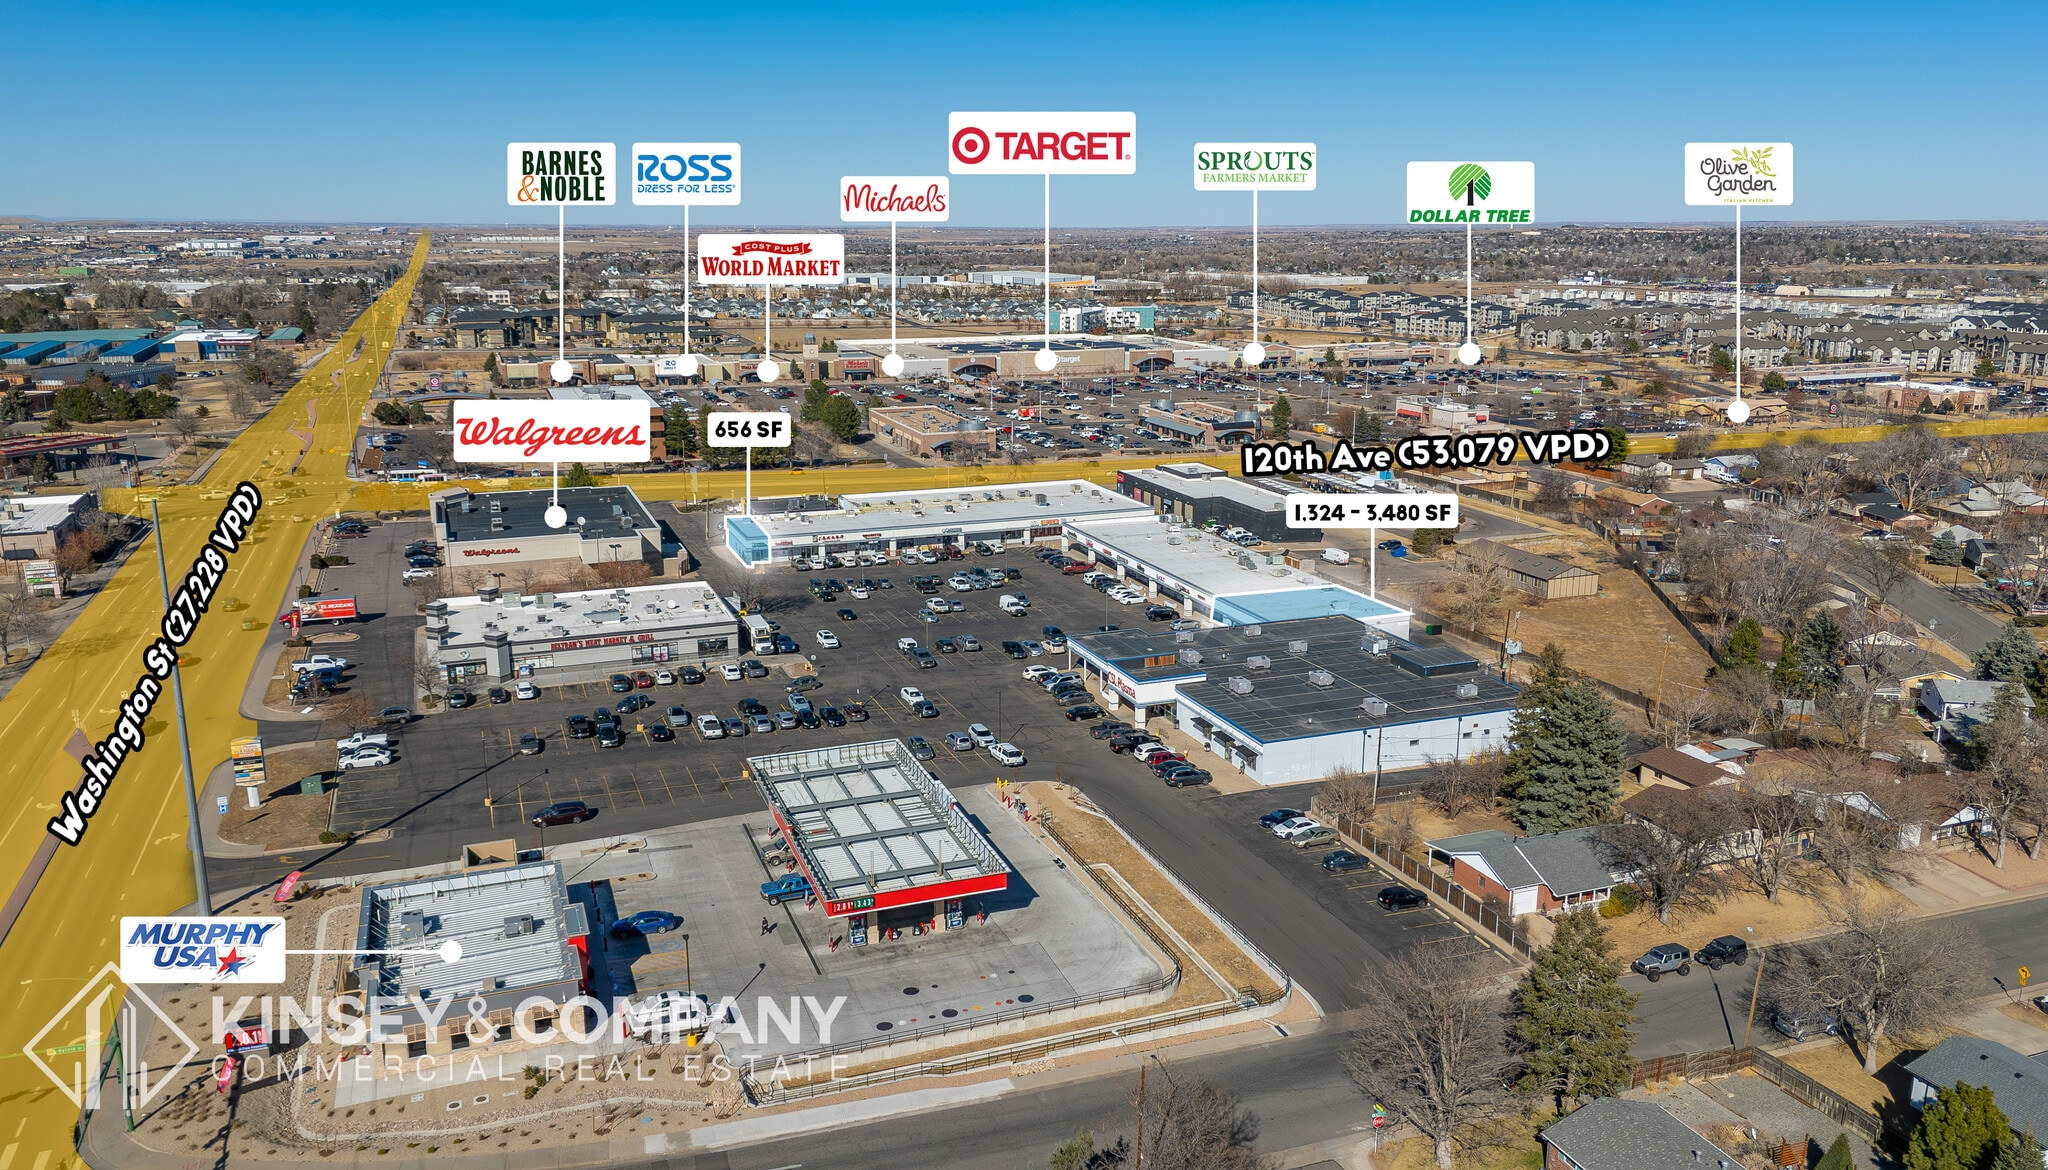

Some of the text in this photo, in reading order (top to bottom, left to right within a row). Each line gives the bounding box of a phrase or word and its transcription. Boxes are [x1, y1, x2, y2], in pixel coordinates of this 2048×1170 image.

[463, 548, 521, 557] Walgreens
[604, 636, 628, 645] MARKET
[637, 633, 655, 642] GRILL
[1116, 676, 1137, 700] Plasma
